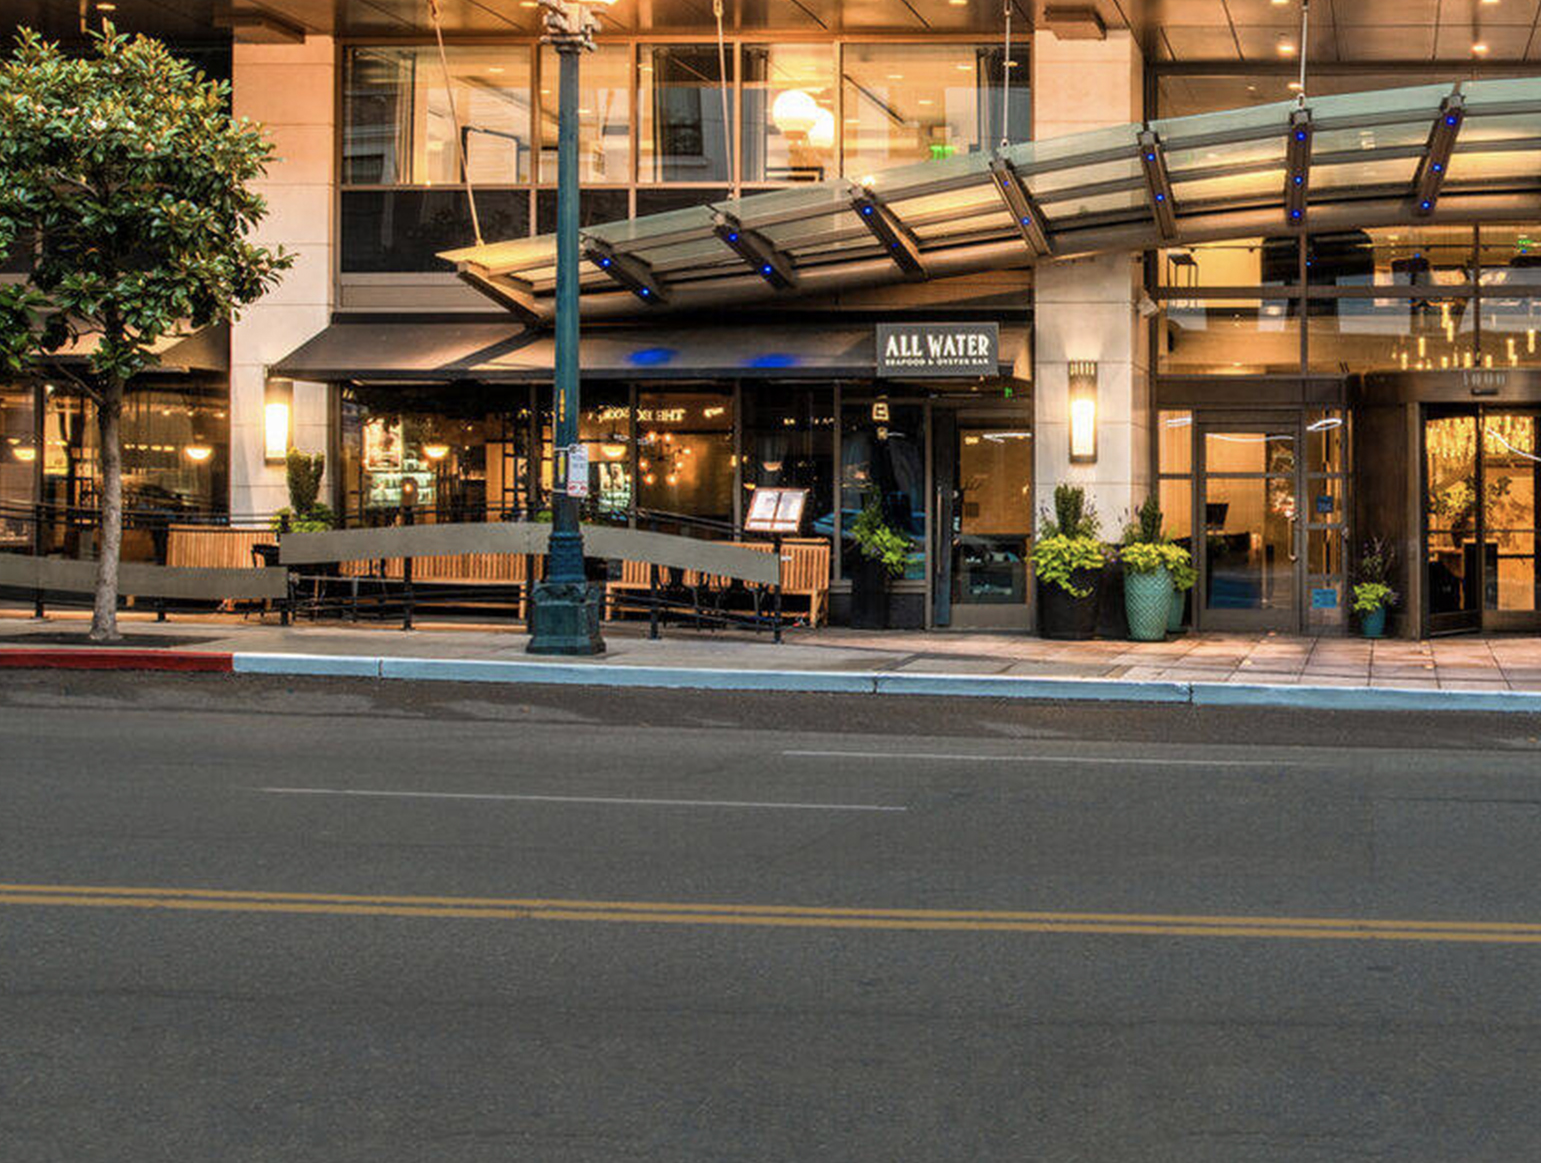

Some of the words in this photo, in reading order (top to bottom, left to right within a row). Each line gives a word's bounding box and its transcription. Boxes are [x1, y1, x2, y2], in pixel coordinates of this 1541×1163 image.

[885, 334, 923, 357] ALL
[926, 334, 989, 358] WATER
[885, 358, 926, 367] SEAFOOD
[936, 358, 970, 367] OYSTER
[972, 358, 989, 366] BAR
